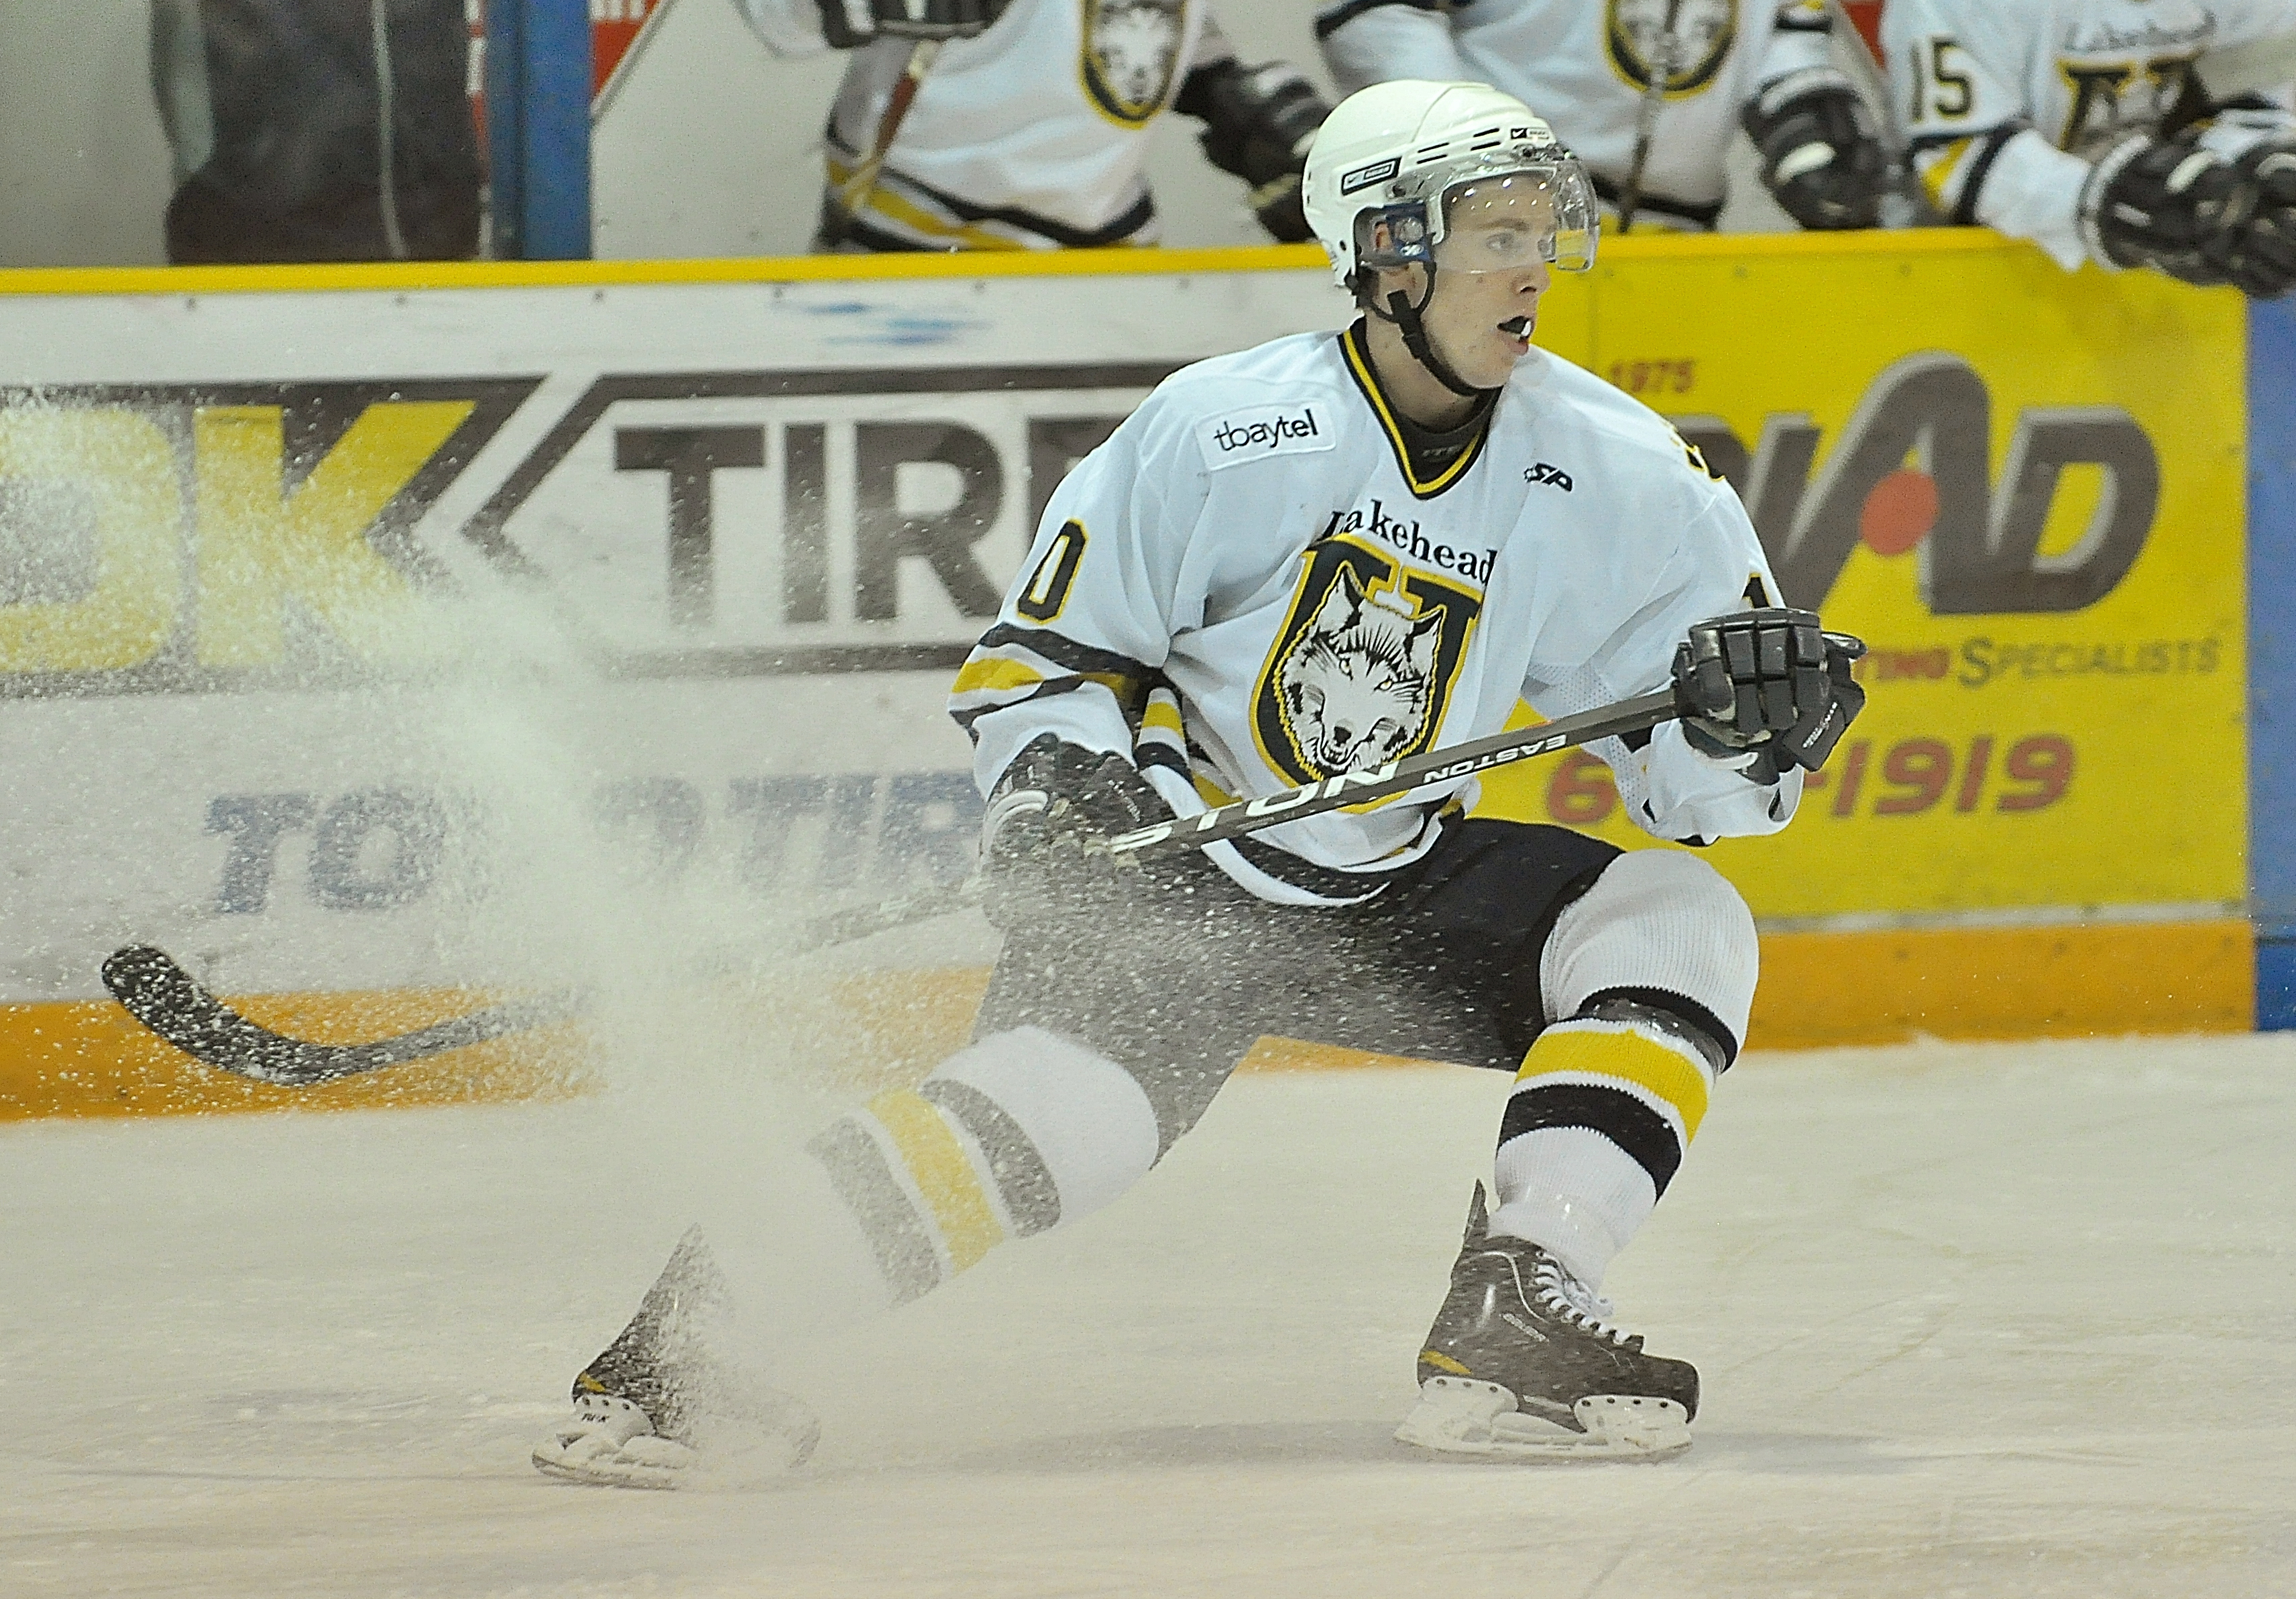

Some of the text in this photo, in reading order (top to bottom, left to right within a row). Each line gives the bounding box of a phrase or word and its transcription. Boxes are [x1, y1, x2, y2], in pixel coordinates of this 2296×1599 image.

[1908, 35, 1971, 122] 15
[1213, 408, 1319, 451] tbaytel
[1423, 734, 1566, 783] EASTON
